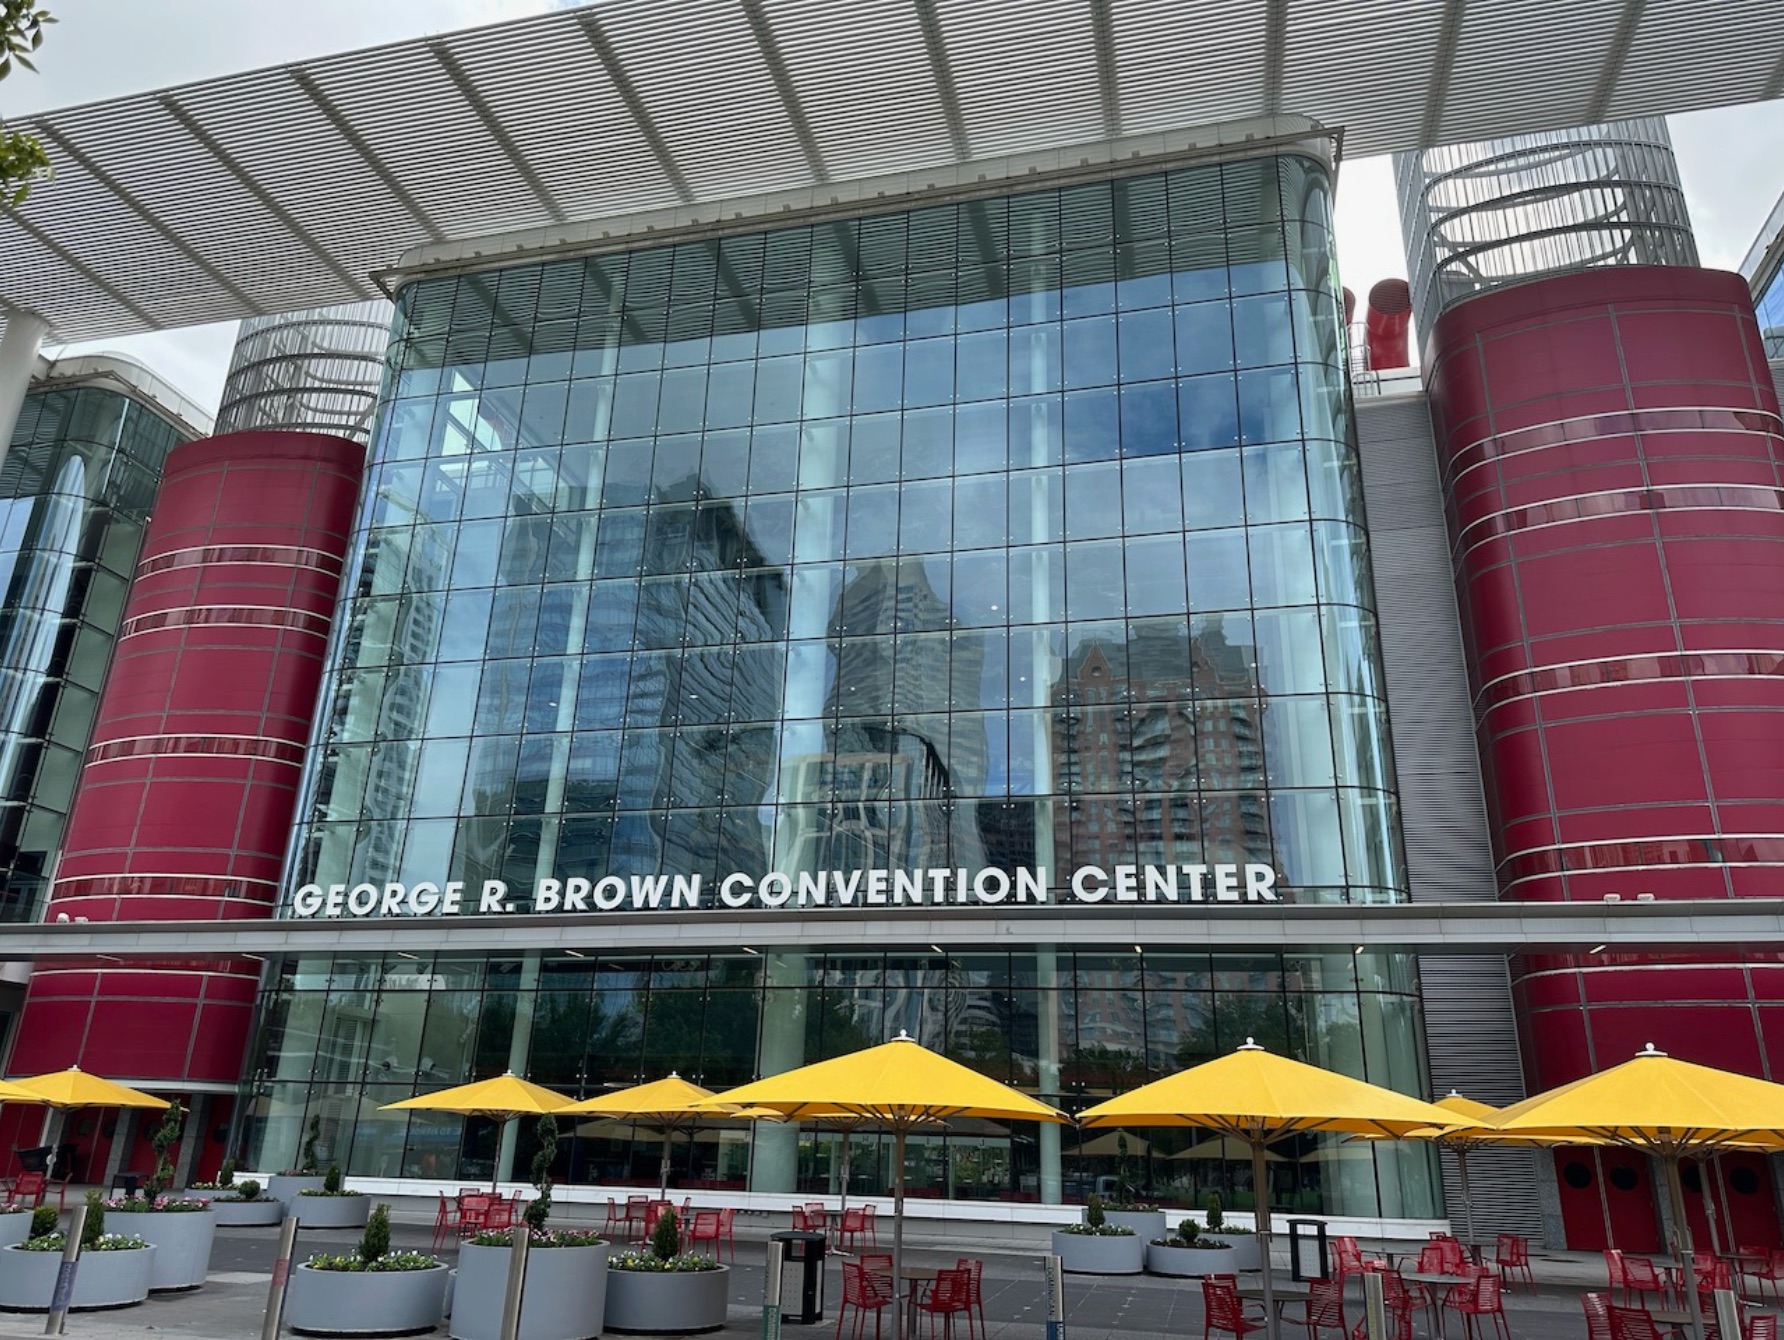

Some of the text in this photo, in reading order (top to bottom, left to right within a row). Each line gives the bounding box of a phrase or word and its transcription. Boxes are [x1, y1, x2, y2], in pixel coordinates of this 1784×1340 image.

[293, 863, 1279, 916] GEORGE R. BROWN CONVENTION CENTER
